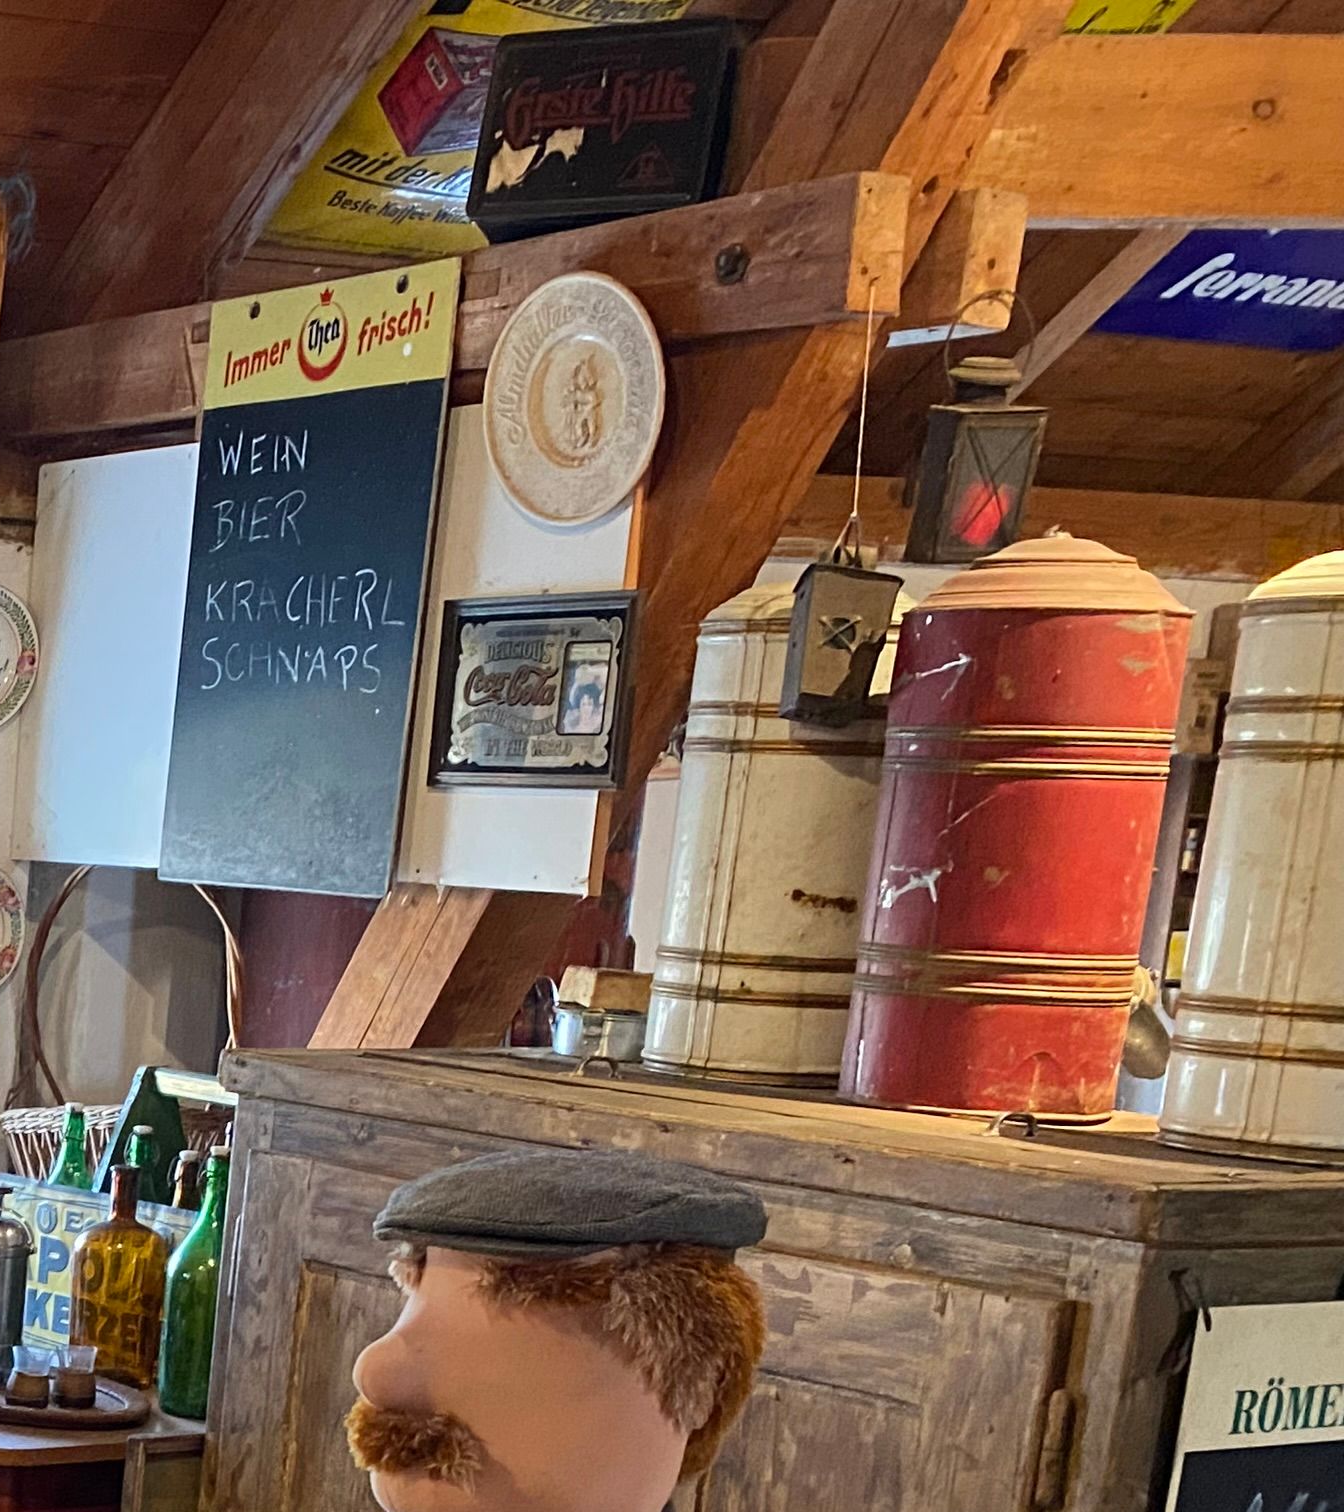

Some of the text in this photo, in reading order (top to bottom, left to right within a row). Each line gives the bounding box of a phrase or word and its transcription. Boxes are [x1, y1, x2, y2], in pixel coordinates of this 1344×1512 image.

[330, 148, 398, 176] mit
[385, 159, 441, 187] der
[328, 190, 377, 213] Beste
[223, 337, 291, 388] Immer
[357, 291, 435, 356] frisch!
[218, 429, 309, 476] WEIN
[209, 489, 308, 553] BIER
[204, 568, 406, 630] KRACHERL
[201, 636, 382, 694] SCHNAPS
[1229, 1378, 1344, 1436] RÖME
